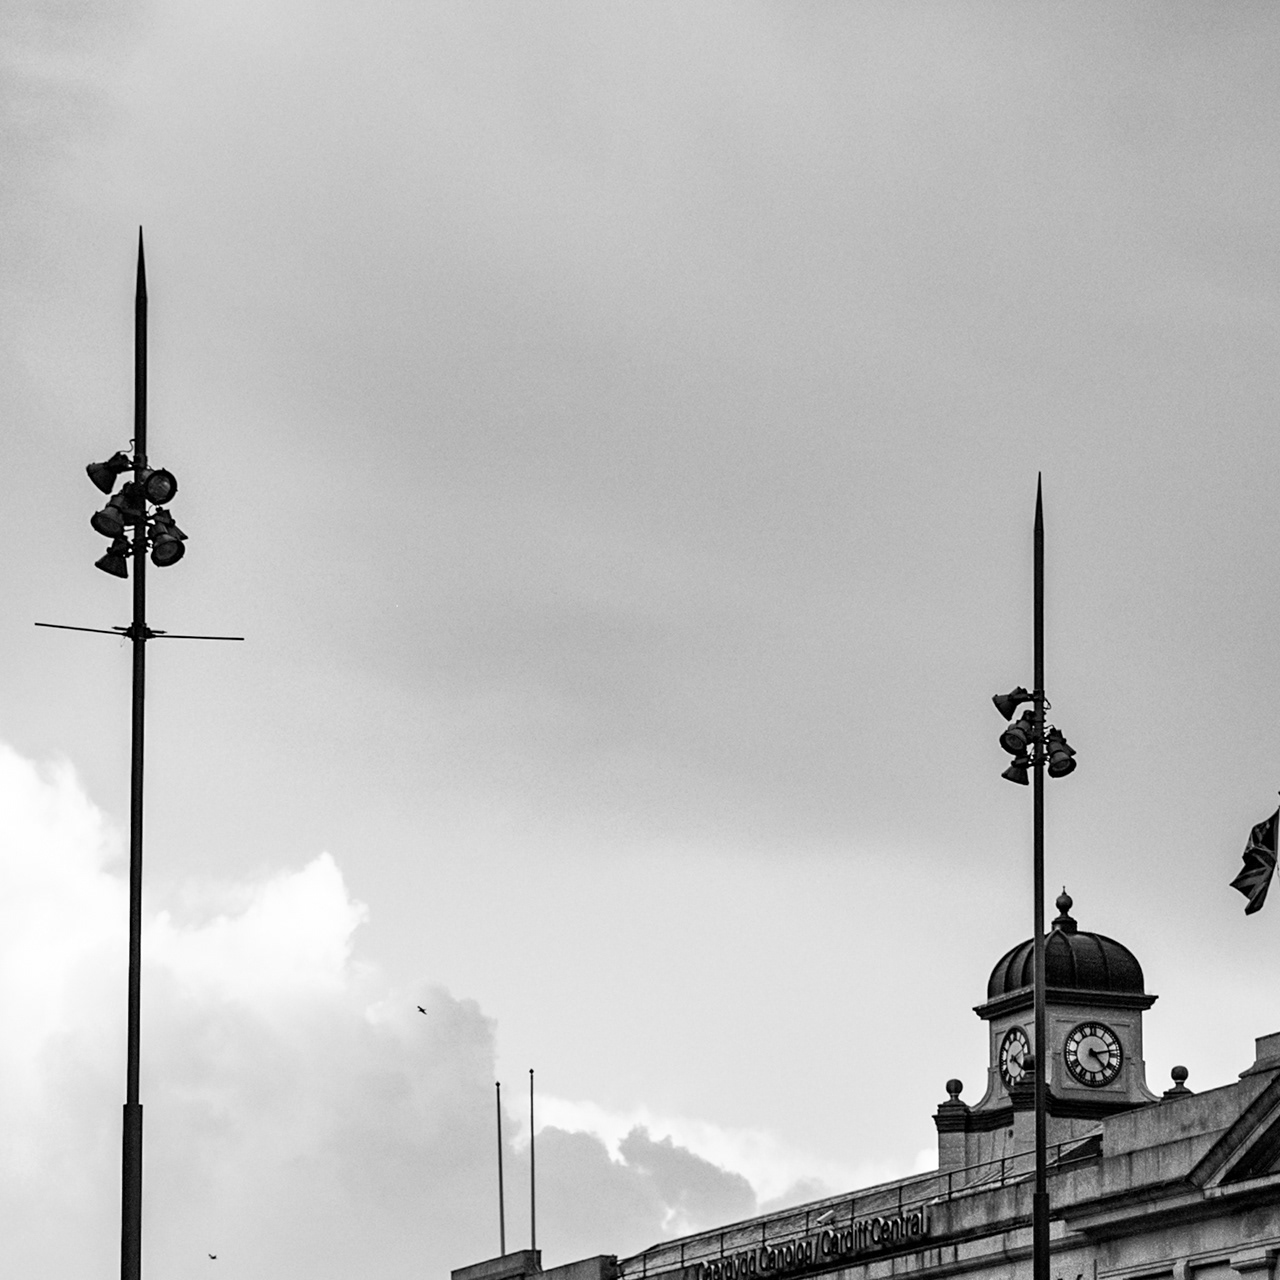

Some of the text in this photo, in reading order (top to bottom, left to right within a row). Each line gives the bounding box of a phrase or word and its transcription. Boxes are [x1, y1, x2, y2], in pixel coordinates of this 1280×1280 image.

[759, 1239, 813, 1271] Canolog
[821, 1220, 869, 1257] Cardiff
[870, 1211, 926, 1245] Central
